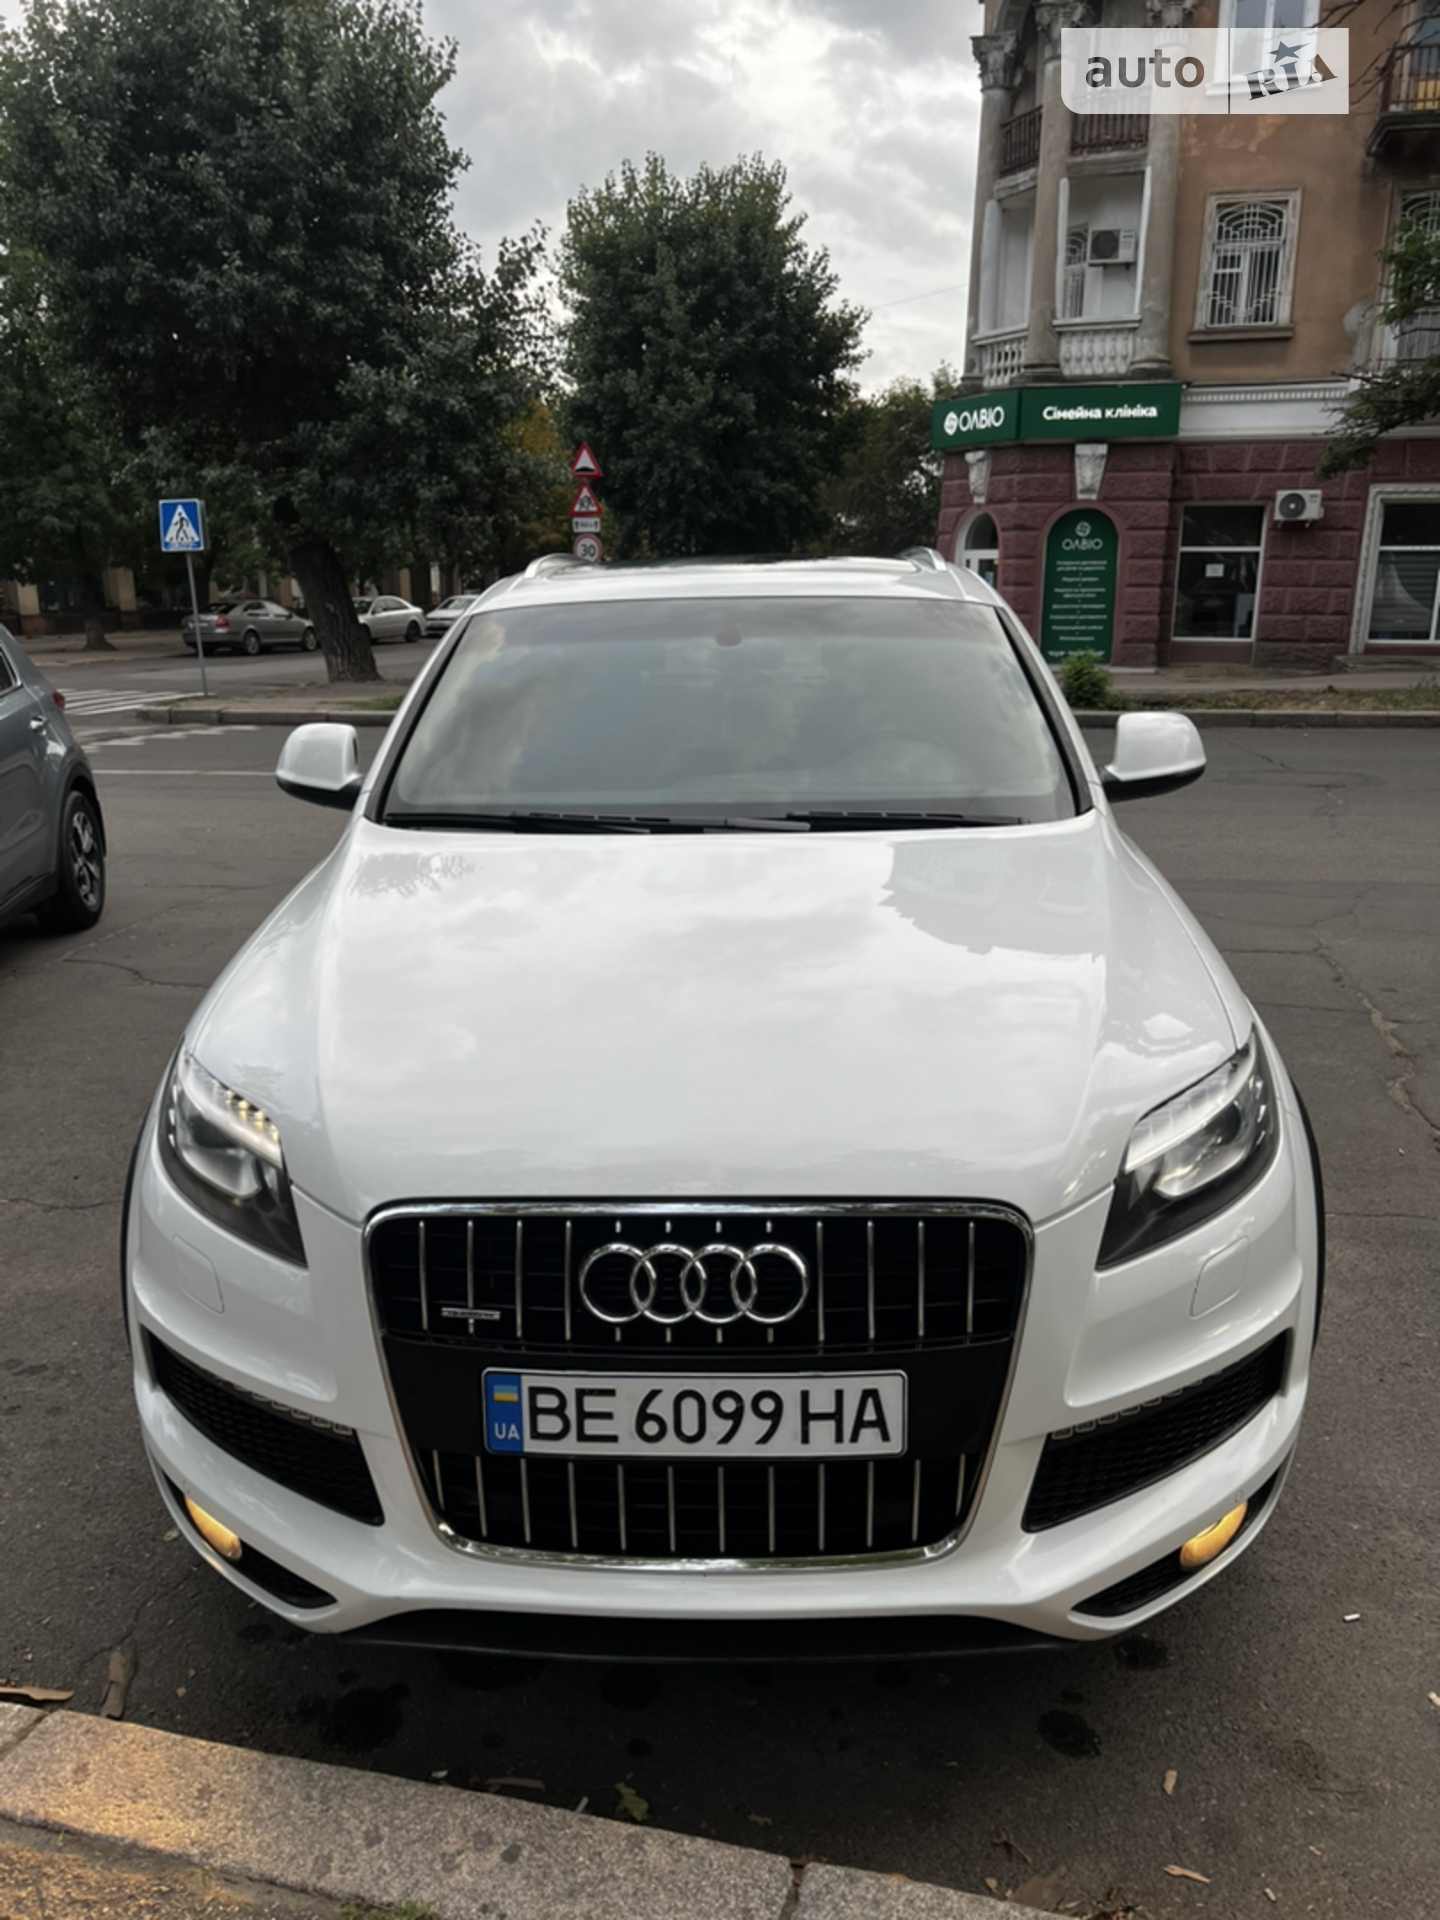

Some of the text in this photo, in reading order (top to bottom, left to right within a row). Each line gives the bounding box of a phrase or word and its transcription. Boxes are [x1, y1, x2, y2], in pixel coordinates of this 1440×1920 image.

[1042, 403, 1158, 421] Сімейна клініка
[580, 543, 597, 558] 30
[528, 1386, 891, 1445] BE 6099 HA
[494, 1422, 520, 1441] UA
